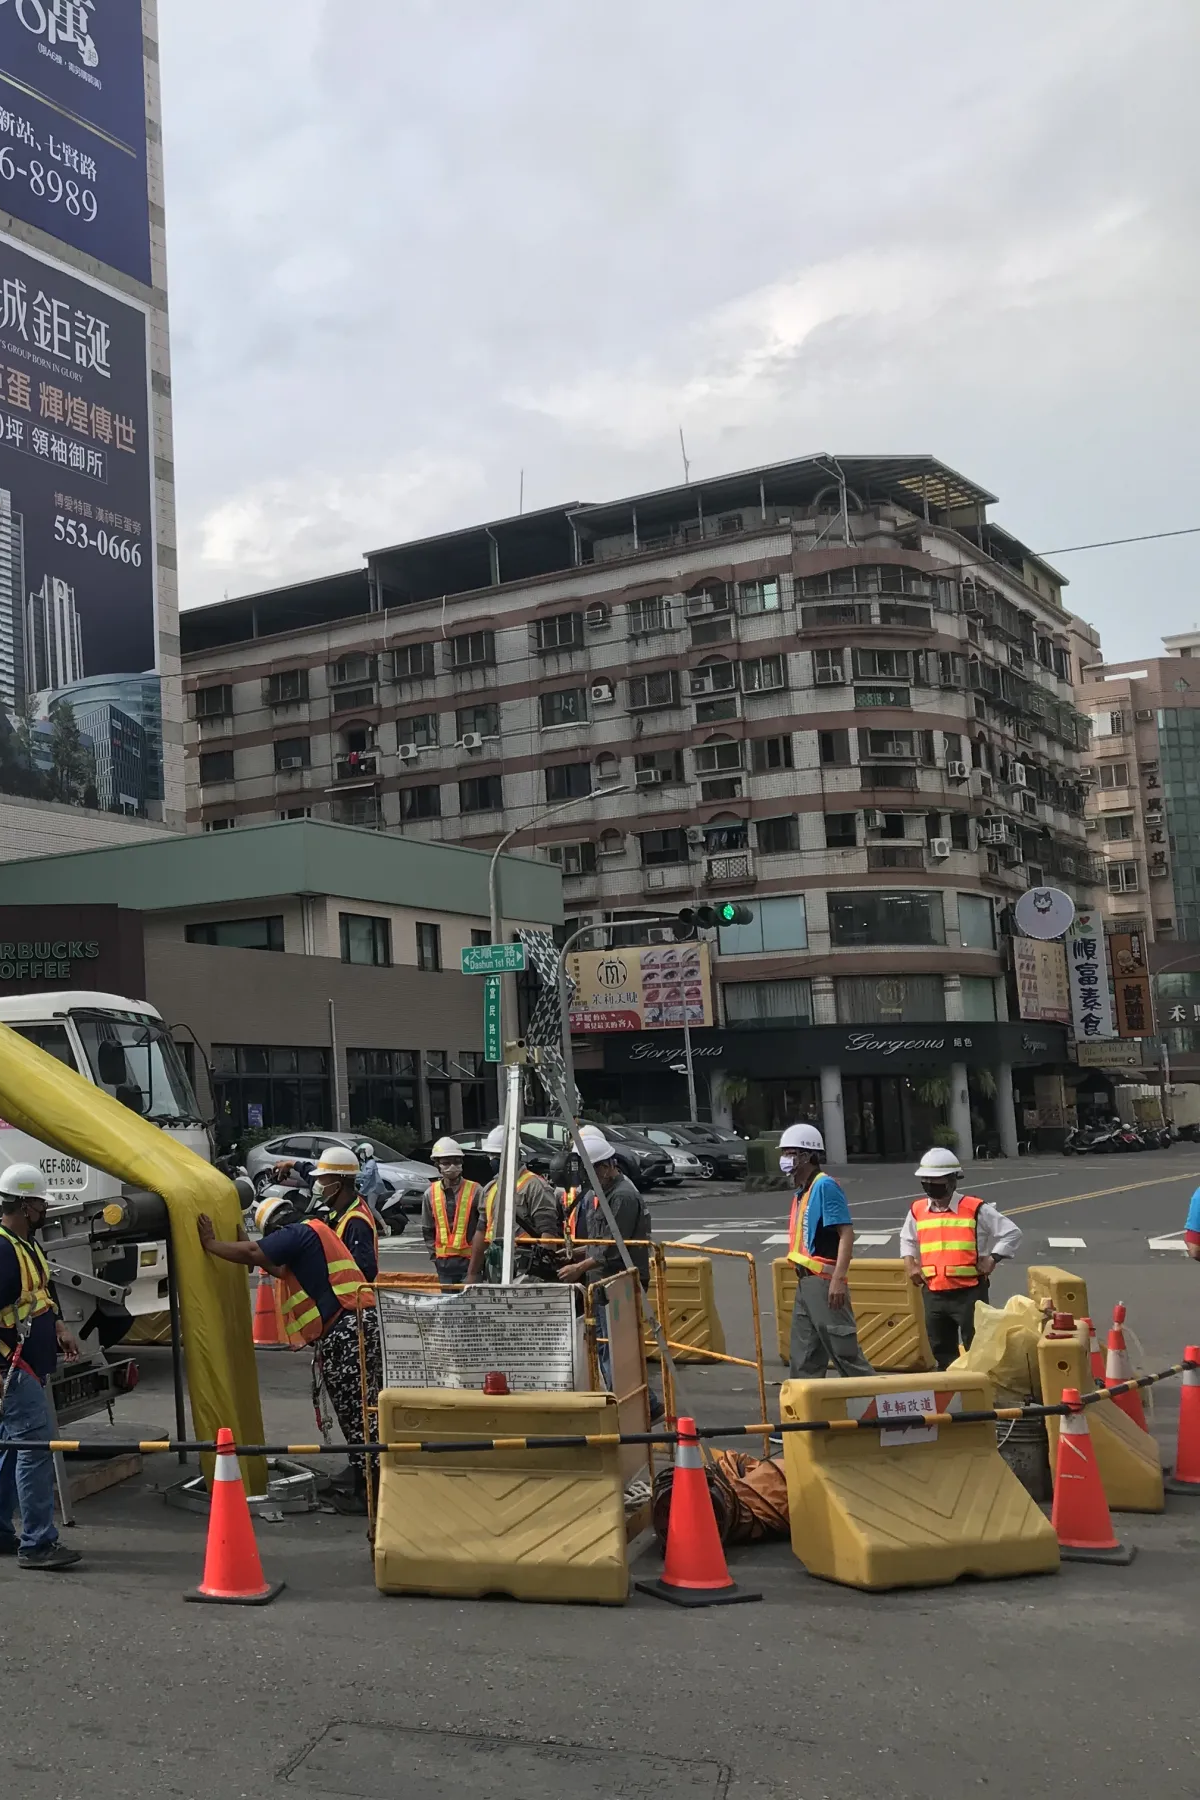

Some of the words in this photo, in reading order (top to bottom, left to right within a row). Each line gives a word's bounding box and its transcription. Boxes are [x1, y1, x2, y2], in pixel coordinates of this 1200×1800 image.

[7, 343, 32, 360] GROUP
[32, 353, 52, 370] BORN
[52, 363, 61, 374] IN
[61, 366, 84, 383] GLORY
[39, 381, 136, 454] 輝煌傳世
[31, 426, 103, 478] 領袖御所
[54, 514, 142, 568] 553-0666
[469, 960, 494, 970] Dashun
[495, 958, 504, 968] 1st
[470, 946, 515, 960] 大順一路
[1073, 937, 1104, 1037] 順富素食
[844, 1033, 945, 1055] Gorgeous
[882, 1397, 933, 1416] 車輛改道
